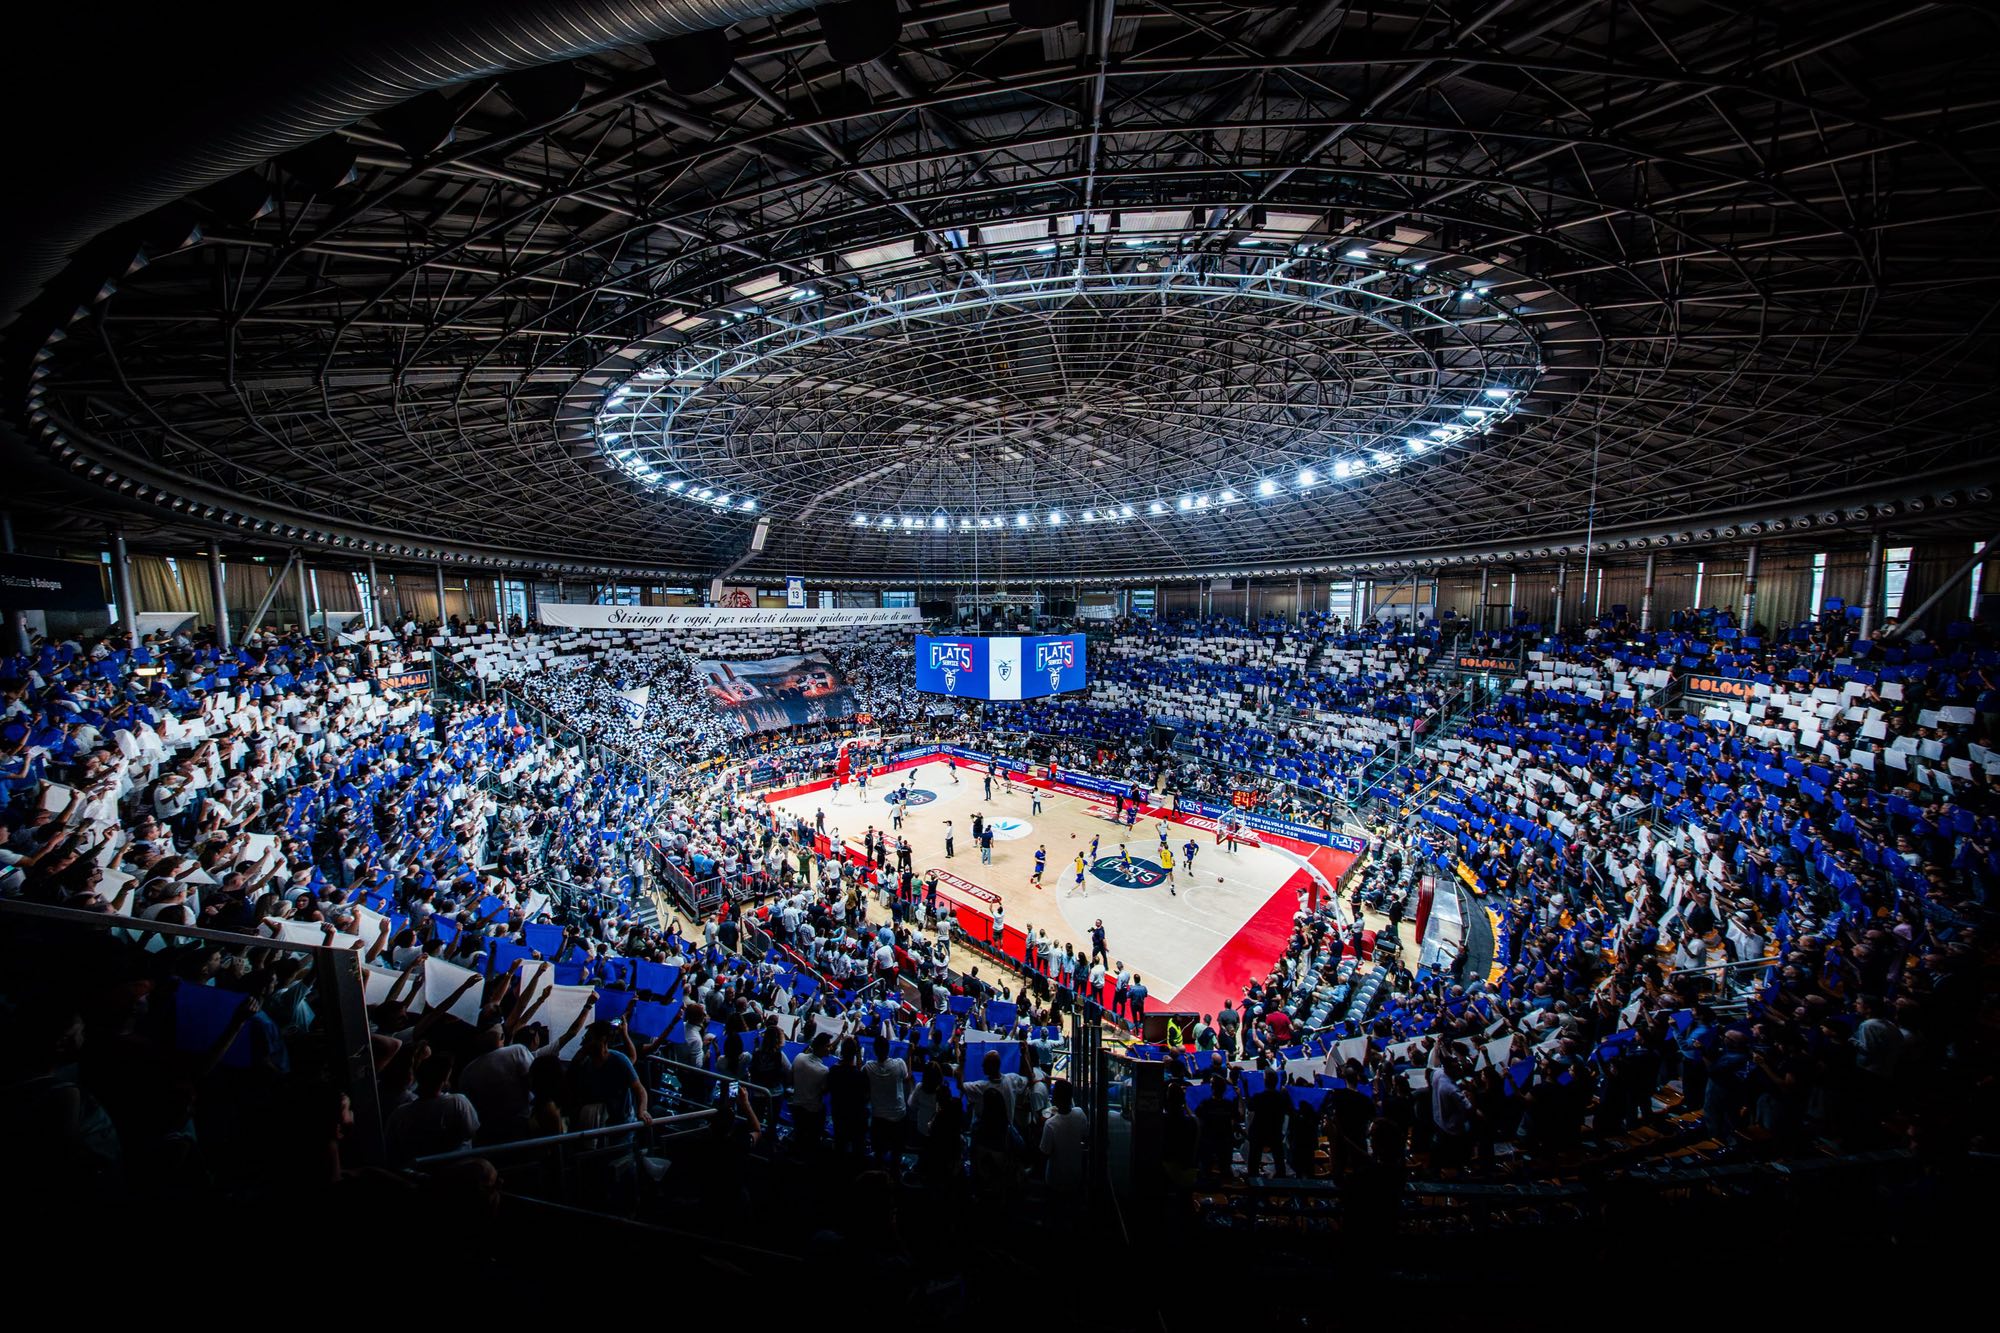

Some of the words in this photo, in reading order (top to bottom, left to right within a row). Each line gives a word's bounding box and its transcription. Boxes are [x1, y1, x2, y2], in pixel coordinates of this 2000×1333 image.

[608, 609, 663, 627] Stringo
[667, 613, 680, 624] te
[714, 614, 735, 627] per
[740, 612, 776, 624] vederti
[779, 612, 818, 623] domani
[819, 612, 853, 625] gridare
[868, 612, 889, 624] forte
[932, 646, 970, 668] FLATS
[1039, 645, 1072, 668] FLATS
[1460, 657, 1516, 671] BOLOGNA
[380, 672, 428, 690] BOLOGNA
[1690, 677, 1755, 696] BOLOGN
[1179, 800, 1201, 813] FLATS
[1234, 795, 1249, 806] 24
[1261, 818, 1284, 829] VALVOLE
[1330, 835, 1361, 852] FLATS
